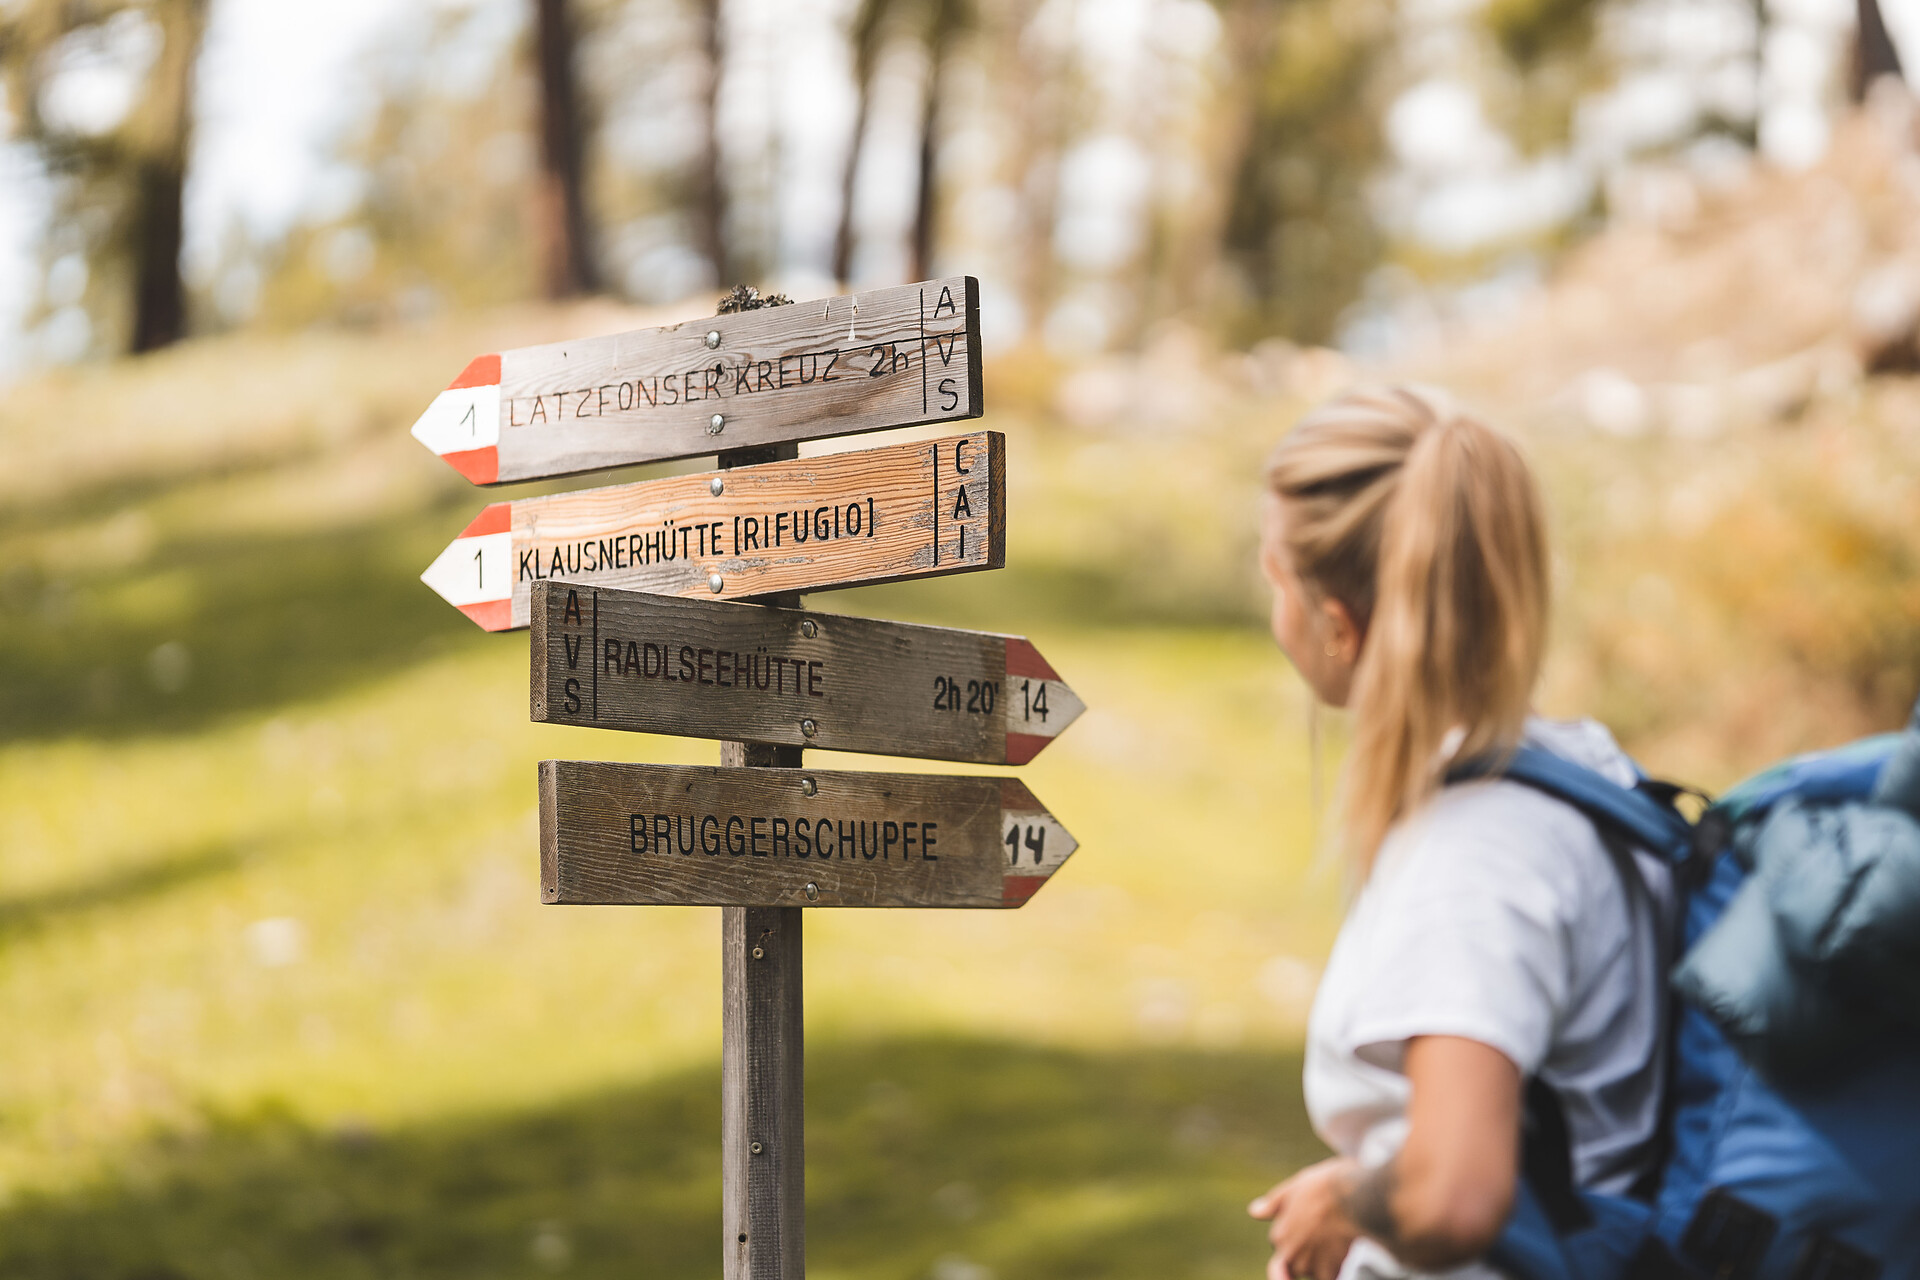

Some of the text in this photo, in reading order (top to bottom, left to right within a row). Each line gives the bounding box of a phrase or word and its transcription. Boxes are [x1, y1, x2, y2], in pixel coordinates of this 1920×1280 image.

[509, 342, 910, 428] LATZFONSER KREUZ 2h
[458, 403, 476, 437] 1
[518, 497, 875, 582] KLAUSNERHÜTTE [RIFUGIO]
[473, 548, 483, 590] 1
[604, 638, 999, 715] RADLSEEHÜTTE 2h 20'
[1020, 681, 1049, 723] 14
[630, 813, 938, 861] BRUGGERSCHUPFE
[1005, 823, 1046, 865] 14
